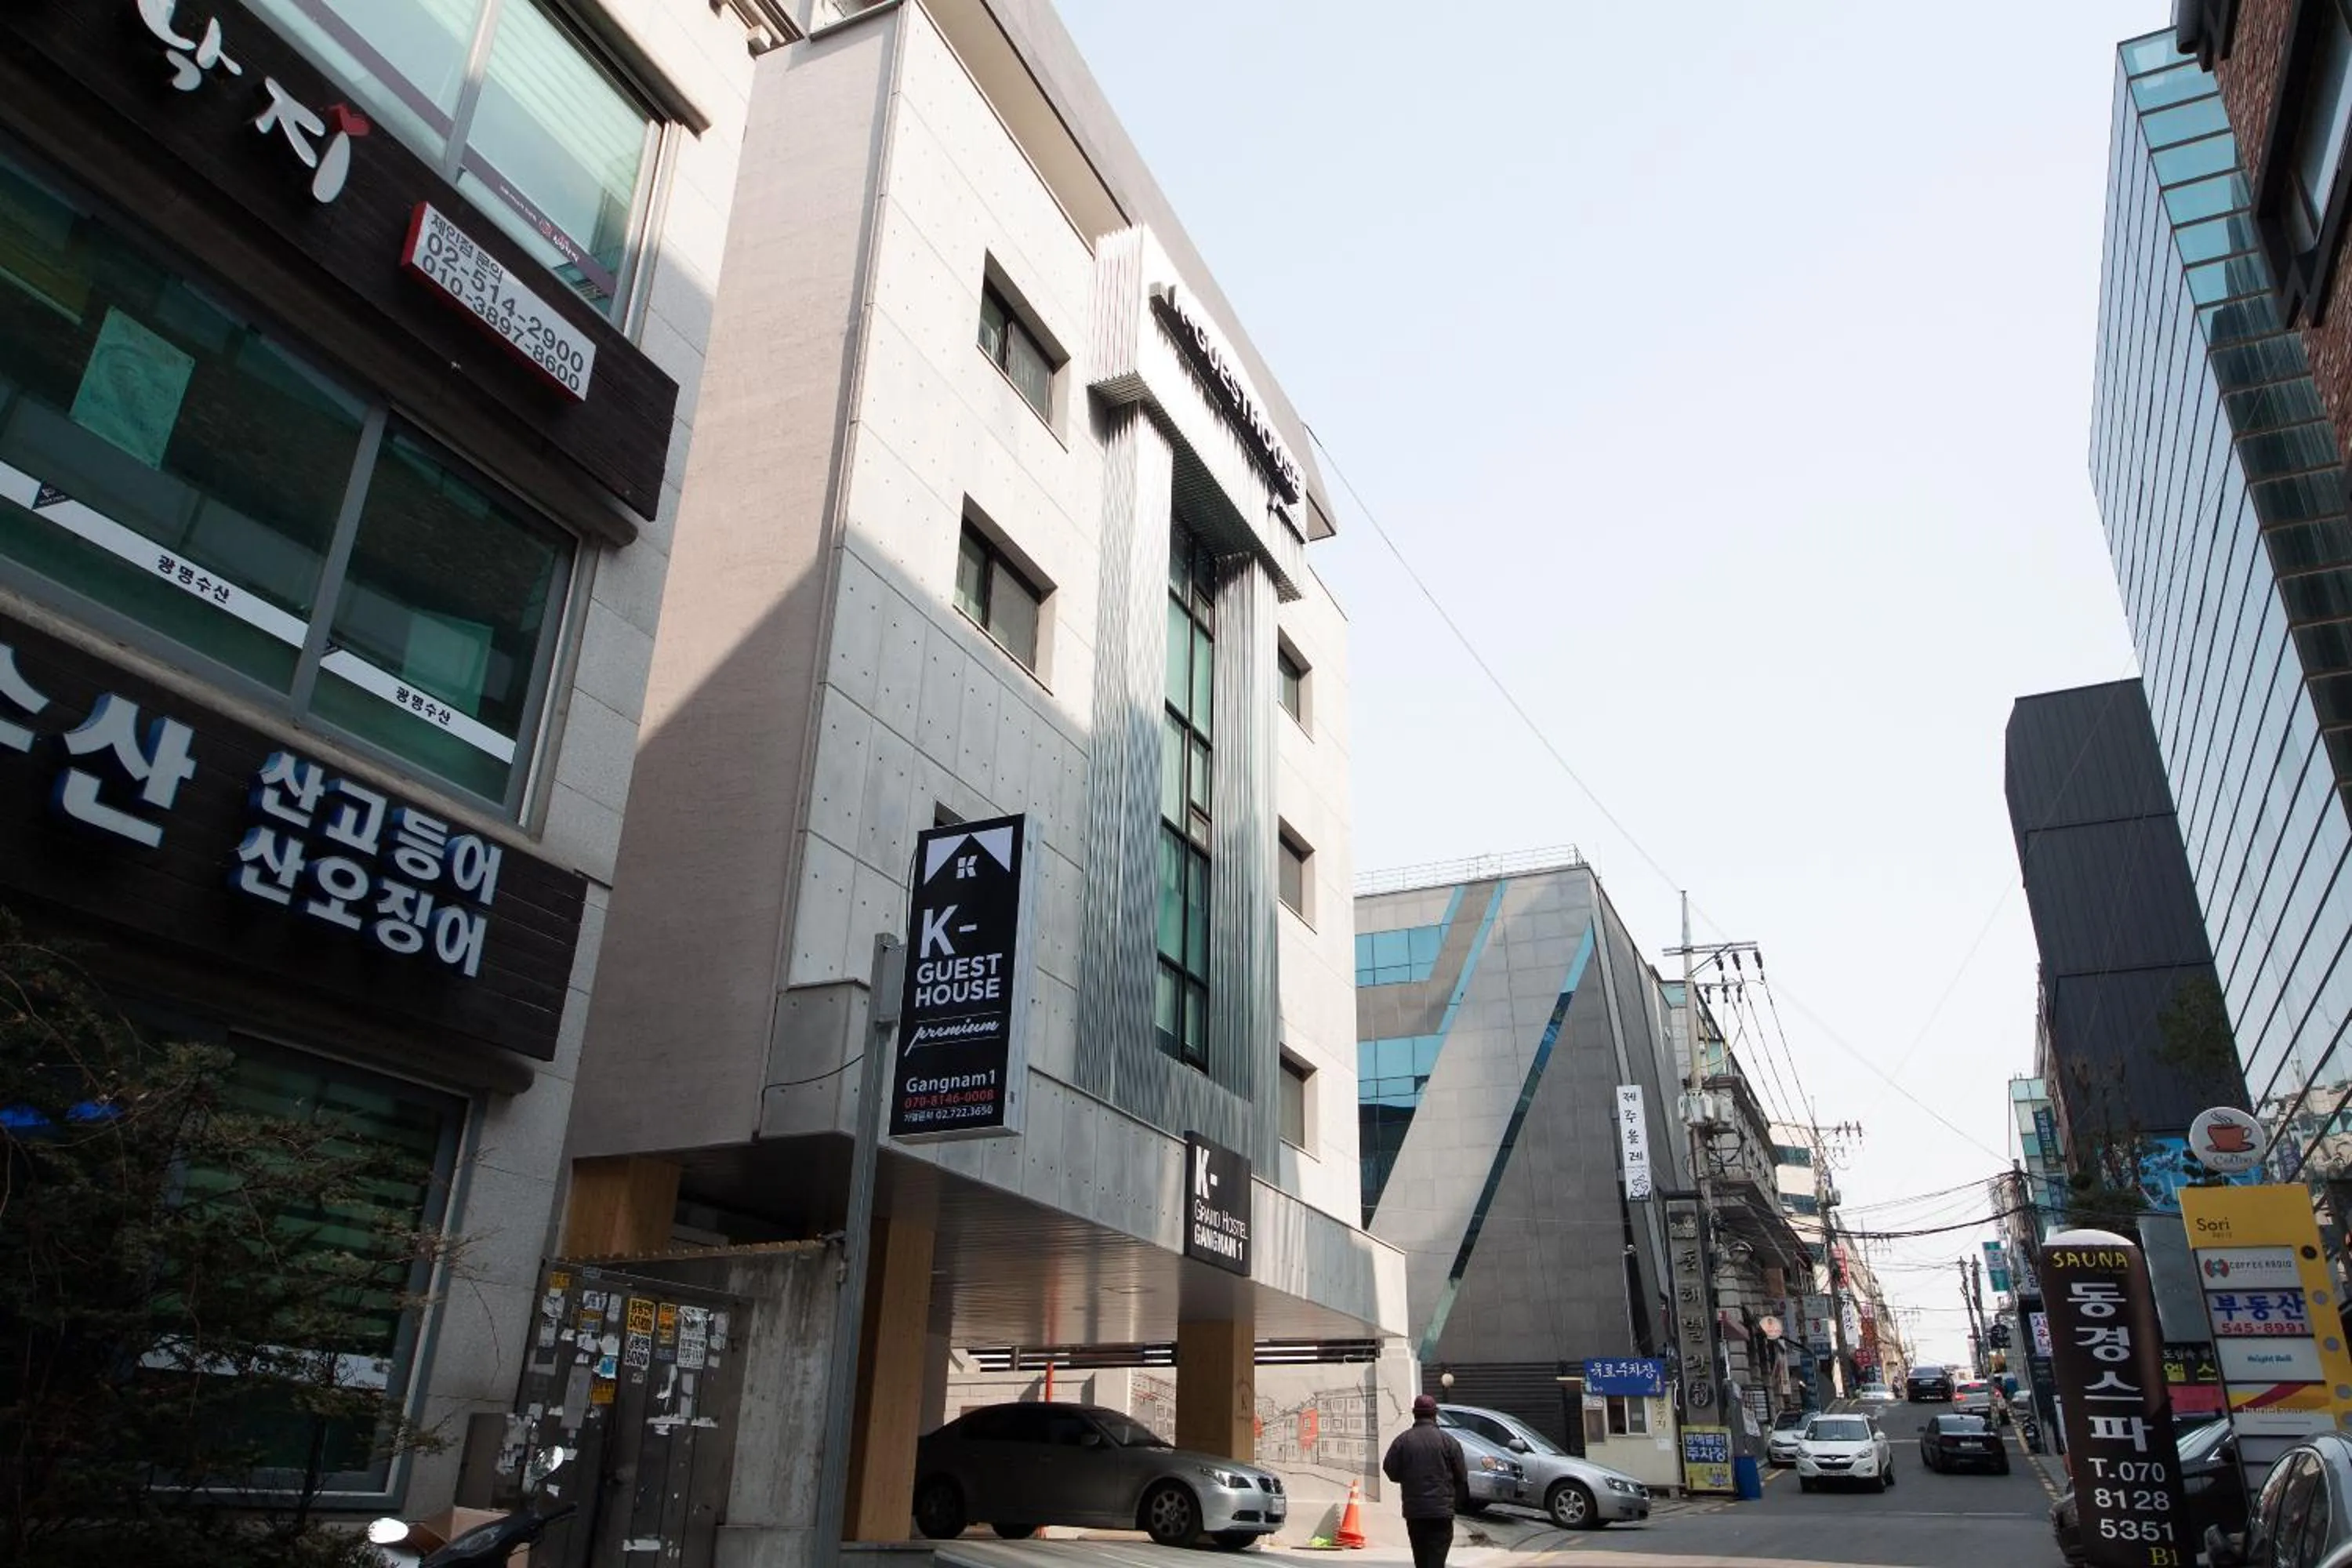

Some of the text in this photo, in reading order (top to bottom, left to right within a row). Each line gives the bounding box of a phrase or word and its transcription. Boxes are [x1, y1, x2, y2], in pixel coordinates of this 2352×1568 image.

[431, 213, 503, 284] 체인점 문의
[427, 231, 584, 373] 02-514-2900
[423, 254, 580, 391] 010-3897-8600
[158, 554, 230, 604] 광명수산
[396, 686, 451, 726] 광명수산
[257, 750, 503, 906] 산고등어
[238, 827, 488, 979] 산오징어
[920, 904, 978, 959] K-
[916, 953, 1003, 984] GUEST
[915, 978, 1000, 1007] HOUSE
[904, 1018, 1000, 1058] premium
[1196, 1145, 1218, 1200] K-
[1194, 1223, 1243, 1261] GANGNAM 1
[2196, 1217, 2230, 1231] Sori
[2053, 1251, 2128, 1269] SAUNA
[2213, 1294, 2305, 1321] 부동산
[2067, 1281, 2154, 1452] 동경스파
[2095, 1488, 2170, 1511] 8128
[2100, 1518, 2174, 1542] 5351
[2149, 1547, 2180, 1566] B1
